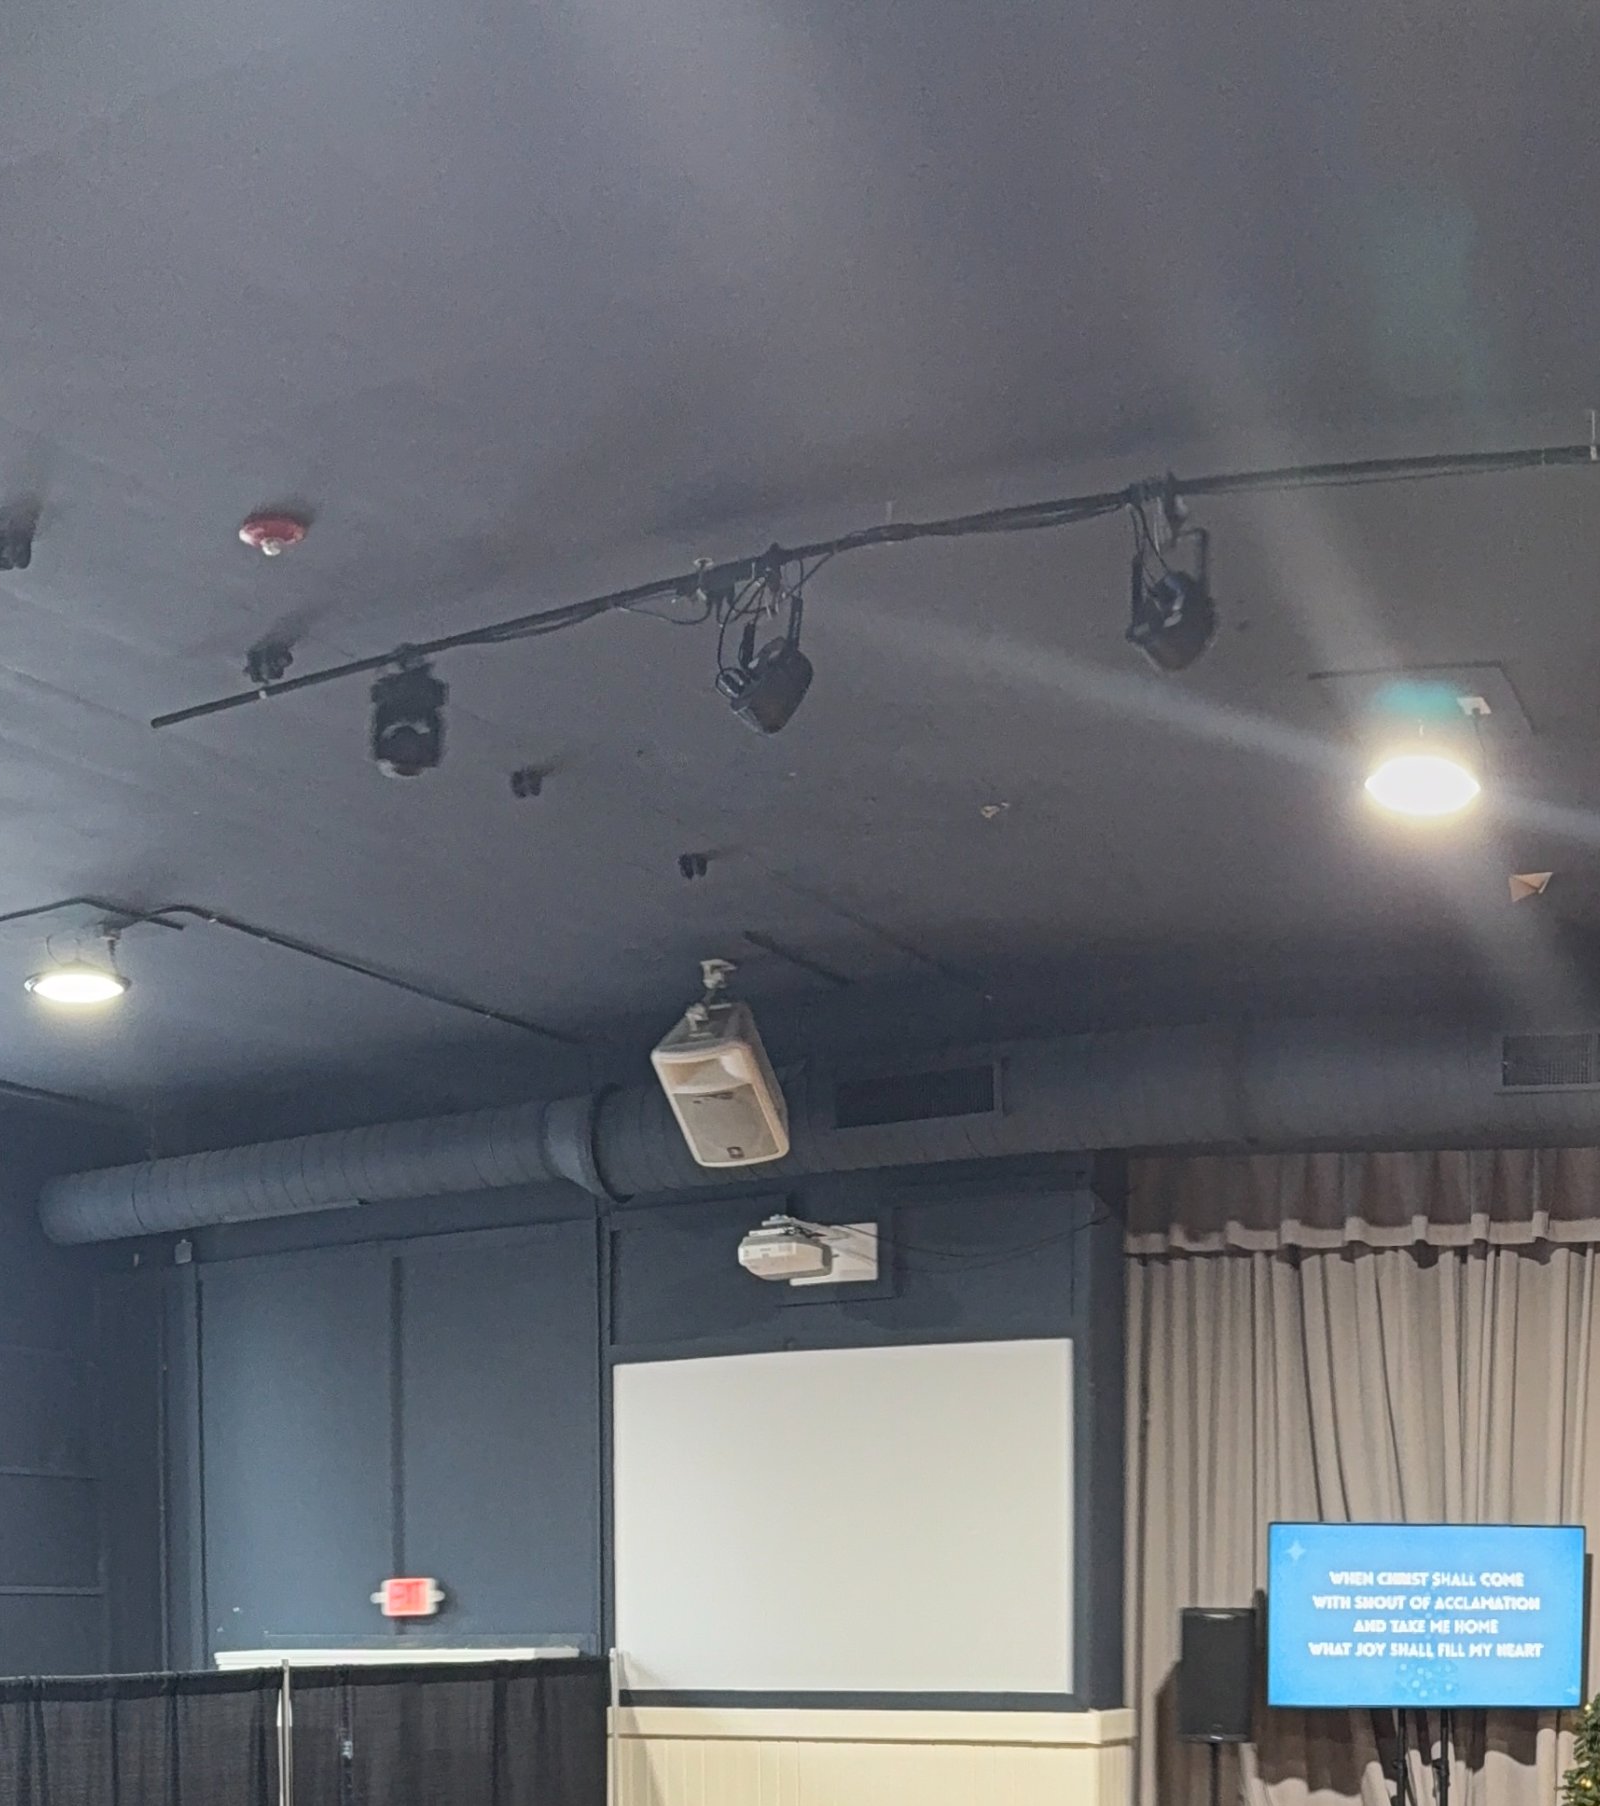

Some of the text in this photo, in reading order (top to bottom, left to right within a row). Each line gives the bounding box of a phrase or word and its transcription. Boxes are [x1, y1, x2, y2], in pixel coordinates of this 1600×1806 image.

[1329, 1572, 1523, 1587] WHEN CHRIST SHALL COME
[1313, 1596, 1539, 1609] WITH SHOUT OF ACCLAMATION
[1354, 1619, 1498, 1634] AND TAKE ME HOME
[1309, 1643, 1543, 1657] WHAT JOY SHALL FILL MY HEART
